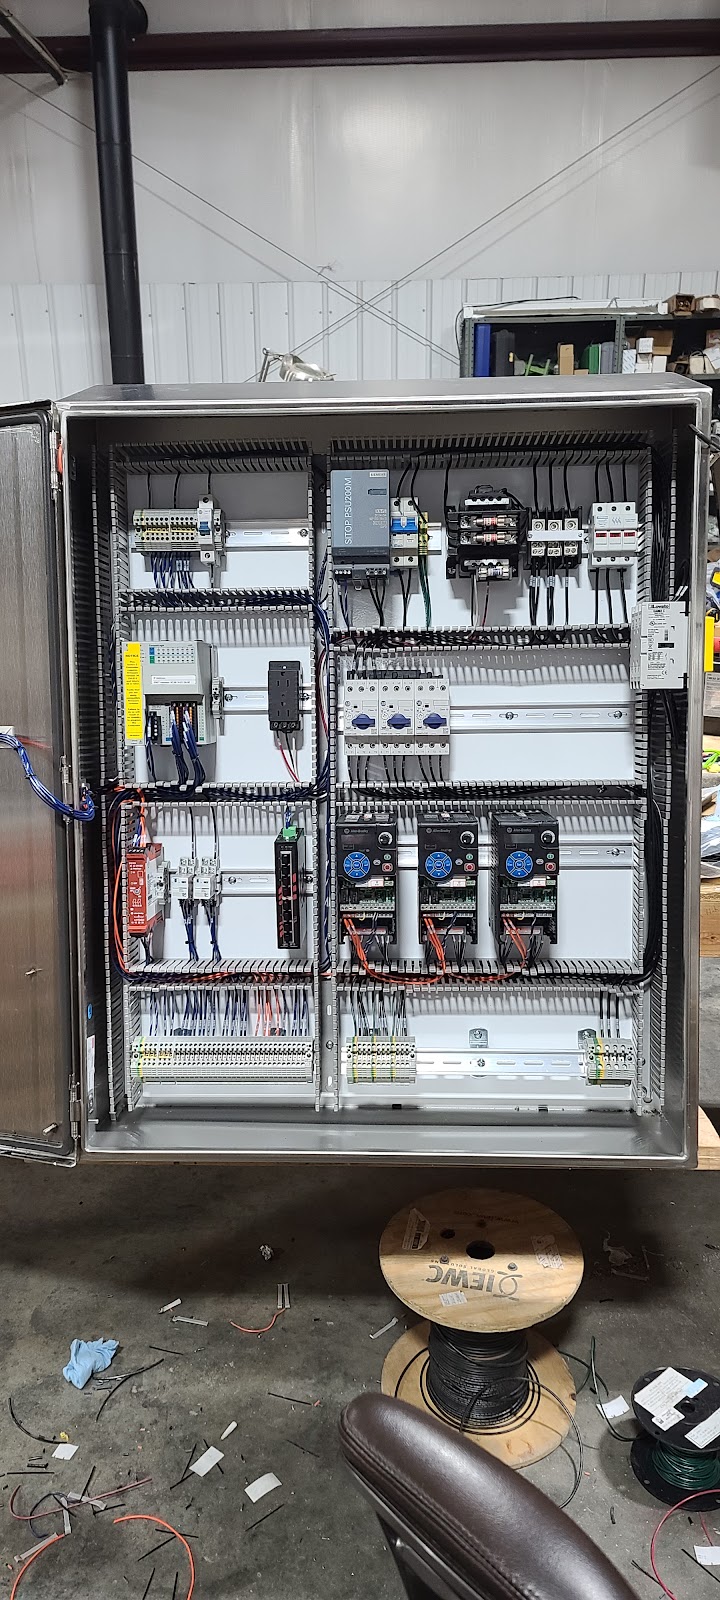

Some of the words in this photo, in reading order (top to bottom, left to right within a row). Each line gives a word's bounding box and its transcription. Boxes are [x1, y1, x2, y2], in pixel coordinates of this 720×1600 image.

[344, 477, 352, 518] PSU200M
[344, 520, 352, 545] SITOP
[426, 1265, 495, 1293] IEWC
